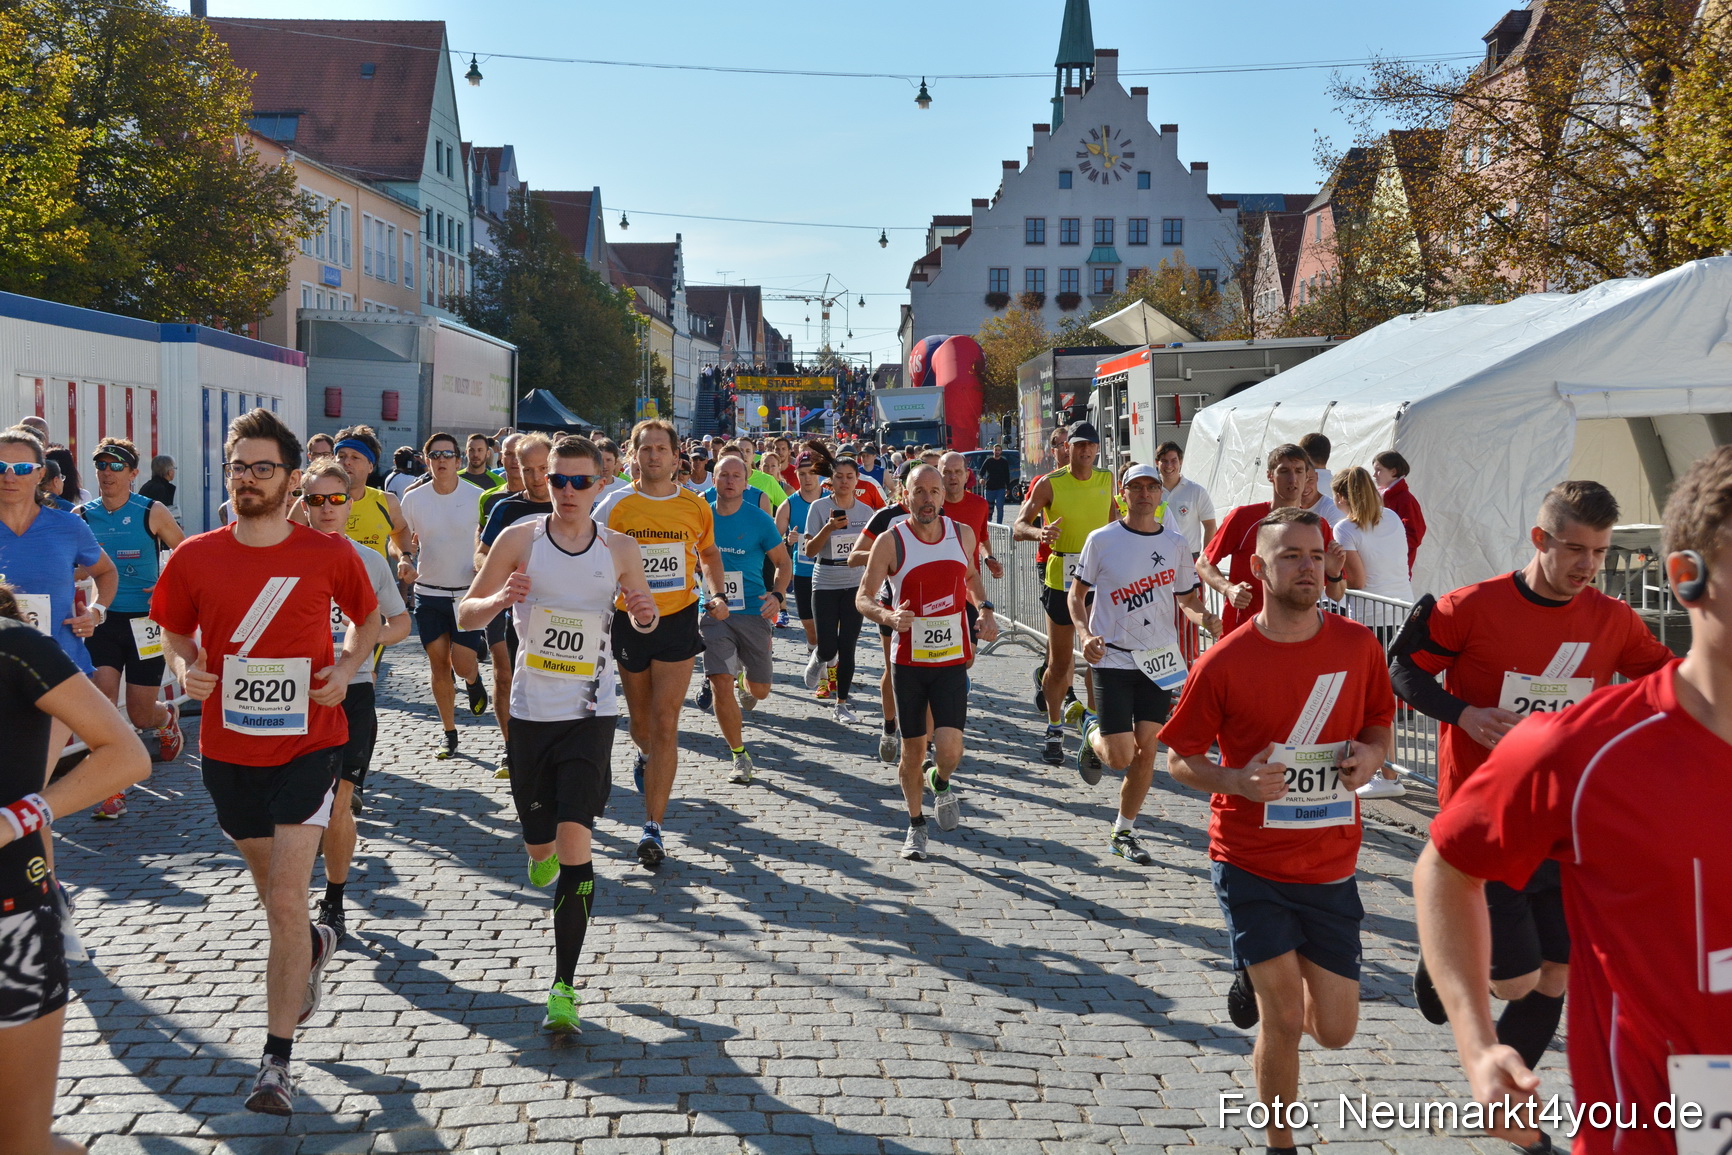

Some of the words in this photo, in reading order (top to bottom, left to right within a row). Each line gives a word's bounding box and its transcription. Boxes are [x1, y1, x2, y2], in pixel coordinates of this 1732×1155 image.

[767, 379, 802, 388] START
[625, 528, 682, 540] Continental
[642, 556, 678, 573] 2246
[1110, 568, 1176, 606] FINISHER
[1123, 587, 1154, 612] 2017
[550, 615, 583, 626] BOCK
[543, 628, 584, 652] 200
[924, 628, 952, 644] 264
[928, 650, 948, 658] Rainer
[247, 664, 285, 673] BOCK
[543, 660, 576, 673] Markus
[1143, 652, 1177, 675] 3072
[234, 678, 296, 703] 2620
[1530, 682, 1568, 693] BOCK
[238, 704, 256, 712] PARTL
[242, 716, 285, 727] Andreas
[1304, 720, 1321, 745] enschen
[1295, 750, 1334, 761] BOCK
[1284, 766, 1340, 794] 2617
[1295, 806, 1328, 820] Daniel
